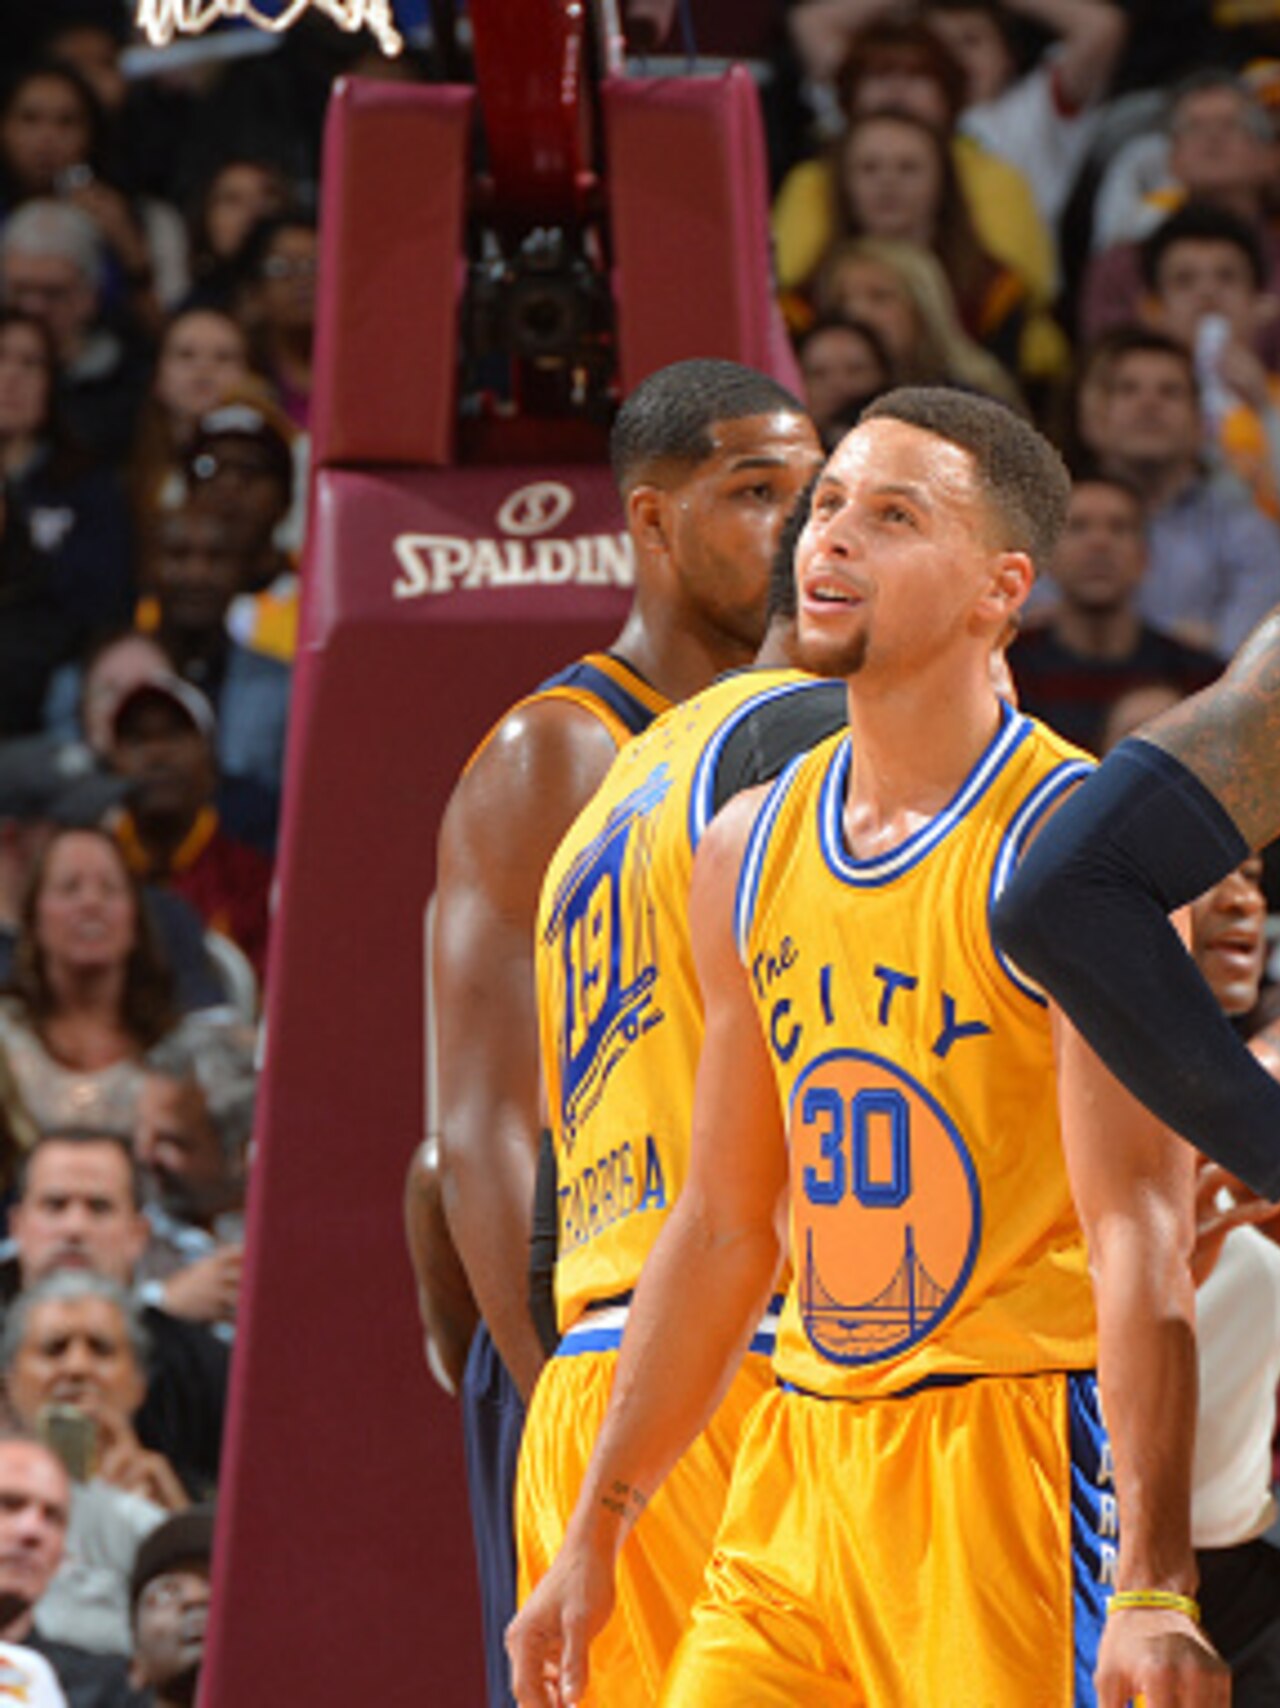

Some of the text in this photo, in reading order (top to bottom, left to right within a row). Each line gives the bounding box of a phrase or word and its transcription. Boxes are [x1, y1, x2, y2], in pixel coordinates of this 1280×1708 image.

[393, 532, 638, 598] SPALDIN
[770, 963, 995, 1065] CITY
[802, 1087, 911, 1208] 30
